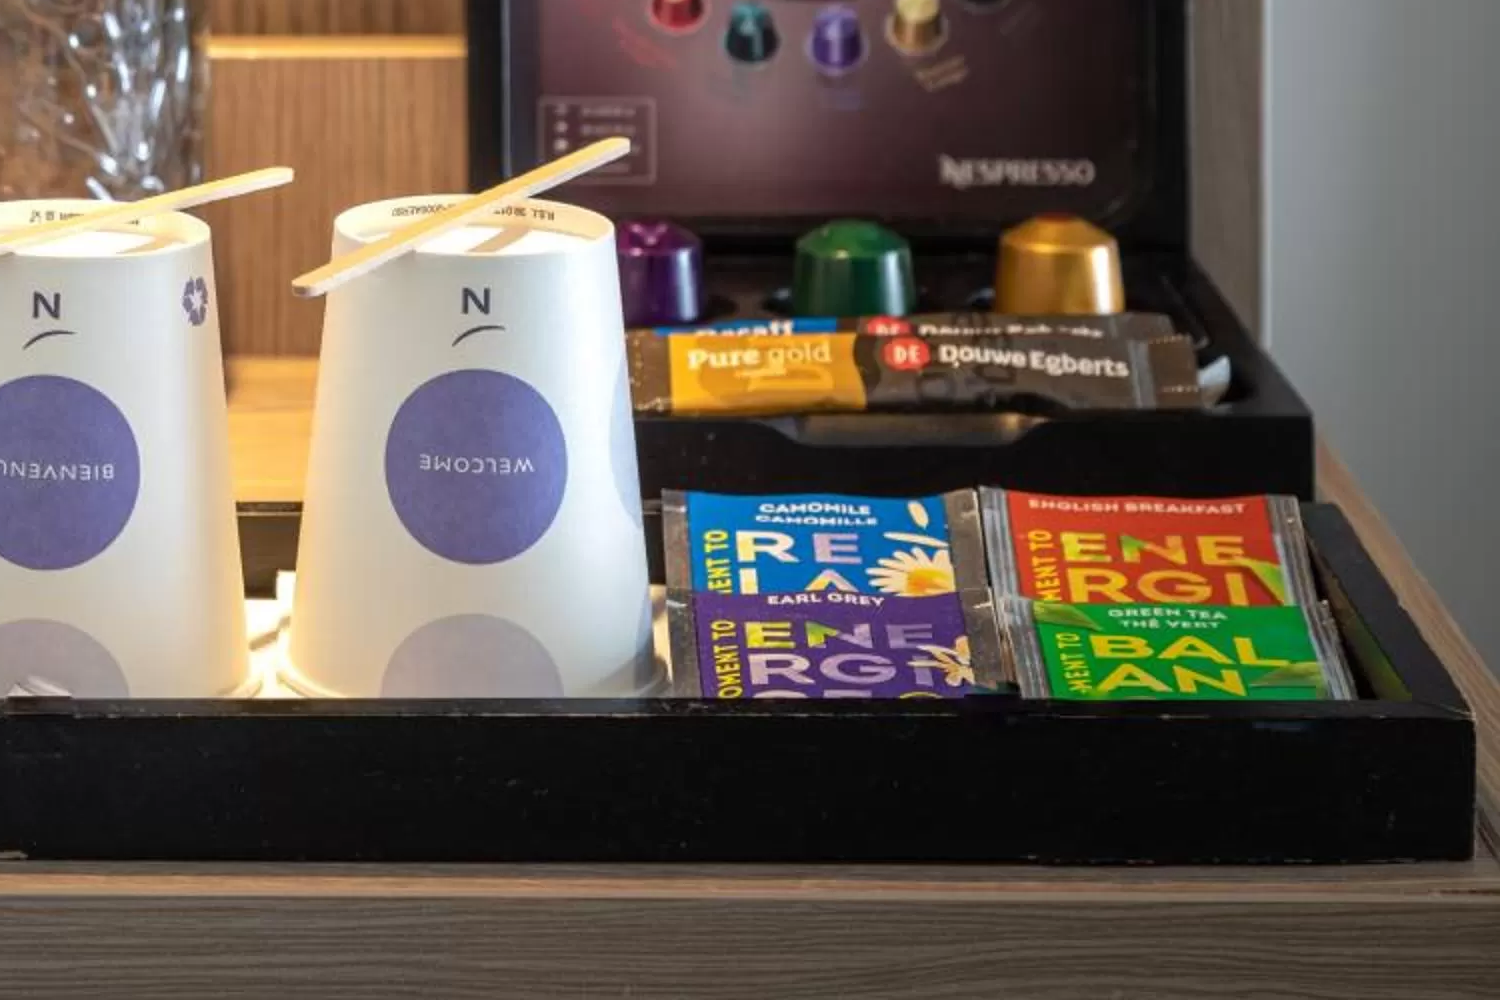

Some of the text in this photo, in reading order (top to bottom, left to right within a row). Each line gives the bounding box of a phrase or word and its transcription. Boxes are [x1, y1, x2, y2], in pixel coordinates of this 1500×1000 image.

[687, 339, 833, 376] Pure gold
[893, 344, 921, 364] DE
[938, 343, 1130, 378] Douwe Egberts
[418, 453, 536, 475] WELCOME
[754, 515, 879, 526] CAMOMILLE
[757, 501, 872, 516] CAMOMILE
[1028, 498, 1249, 515] ENGLISH BREAKFAST
[704, 529, 729, 553] TO
[736, 530, 863, 565] RE
[1060, 531, 1246, 565] ENE
[1027, 528, 1062, 603] MENT TO
[766, 592, 886, 607] EARL GREY
[1065, 567, 1250, 605] RGI
[1107, 607, 1229, 620] GREEN TEA
[1168, 619, 1221, 629] VERT
[744, 620, 934, 650] ENE
[711, 618, 744, 698] OMENT TO
[1056, 632, 1092, 693] MENT TO
[1090, 634, 1292, 667] BAL
